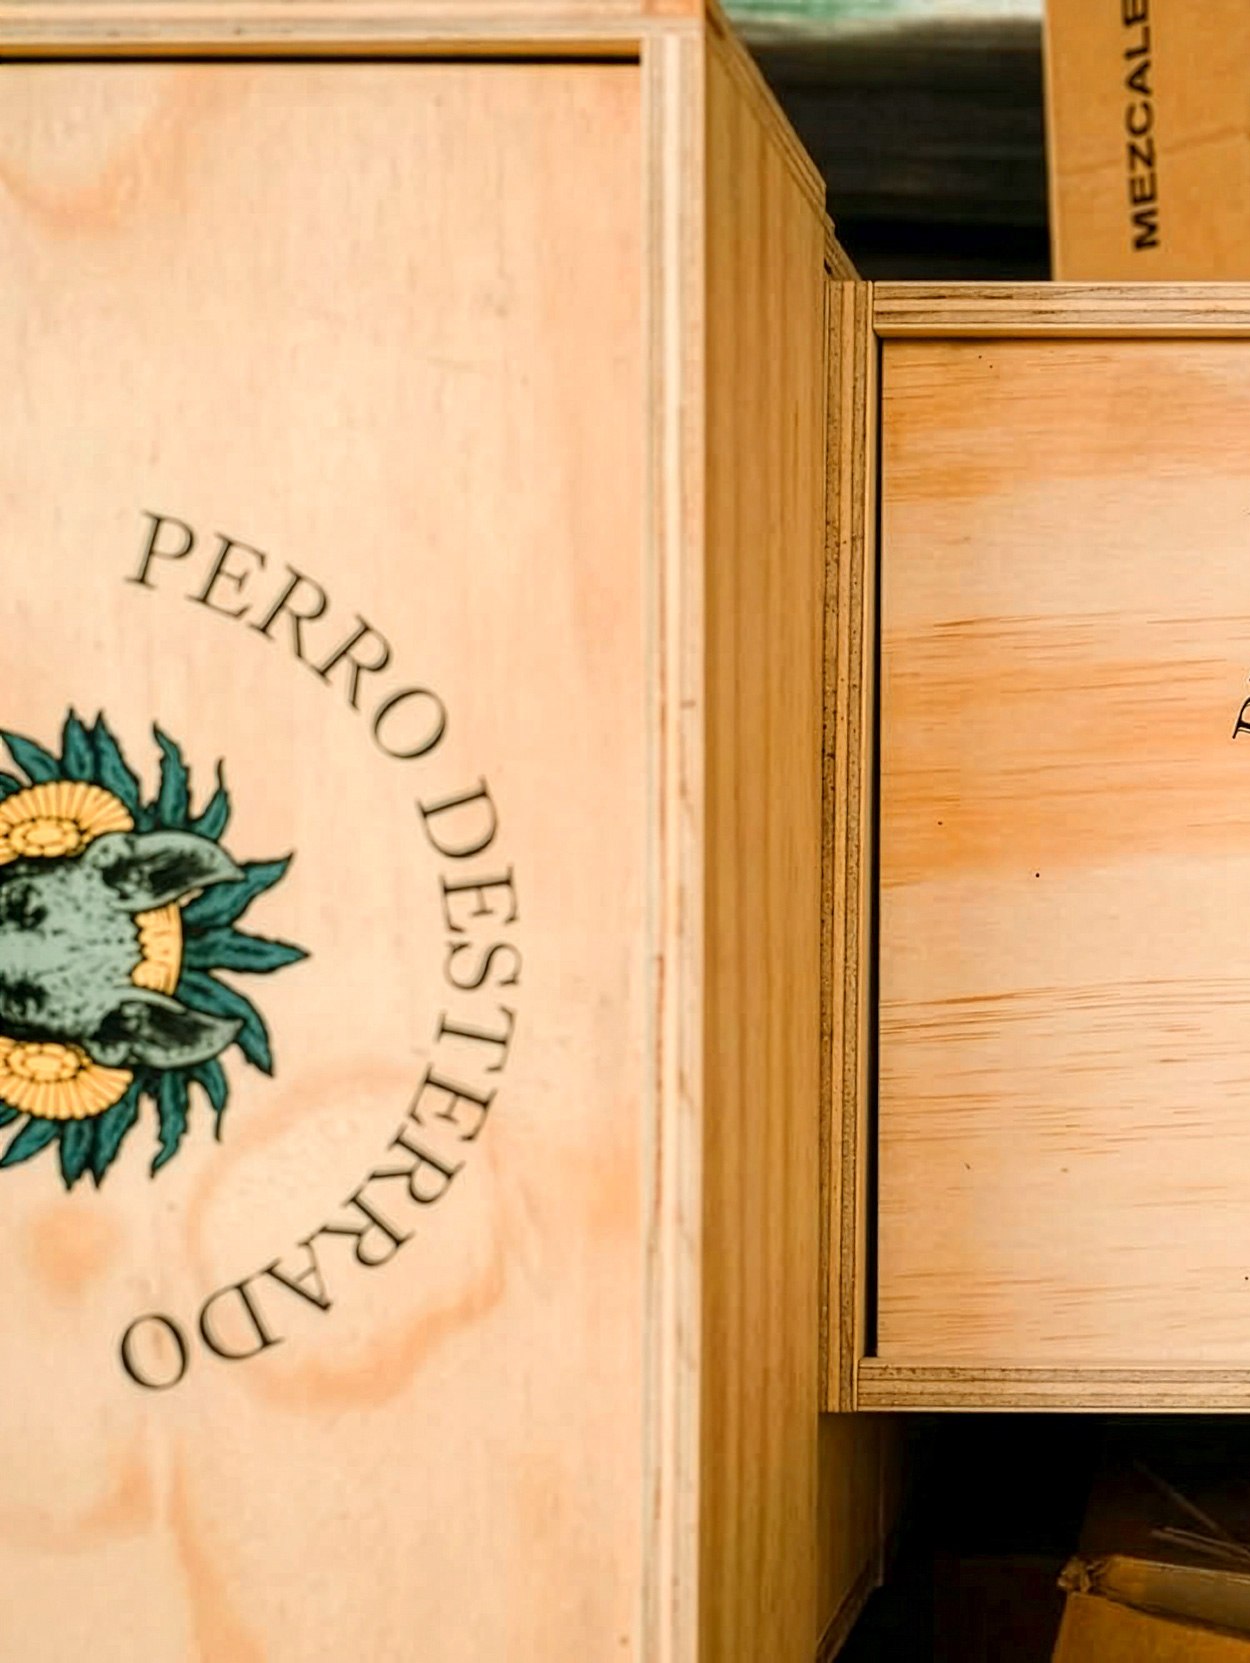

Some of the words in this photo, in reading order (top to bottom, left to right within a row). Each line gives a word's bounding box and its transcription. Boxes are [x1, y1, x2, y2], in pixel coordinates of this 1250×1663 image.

[1121, 0, 1160, 251] MEZCALE
[125, 510, 448, 760] PERRO
[118, 777, 523, 1391] DESTERRADO
